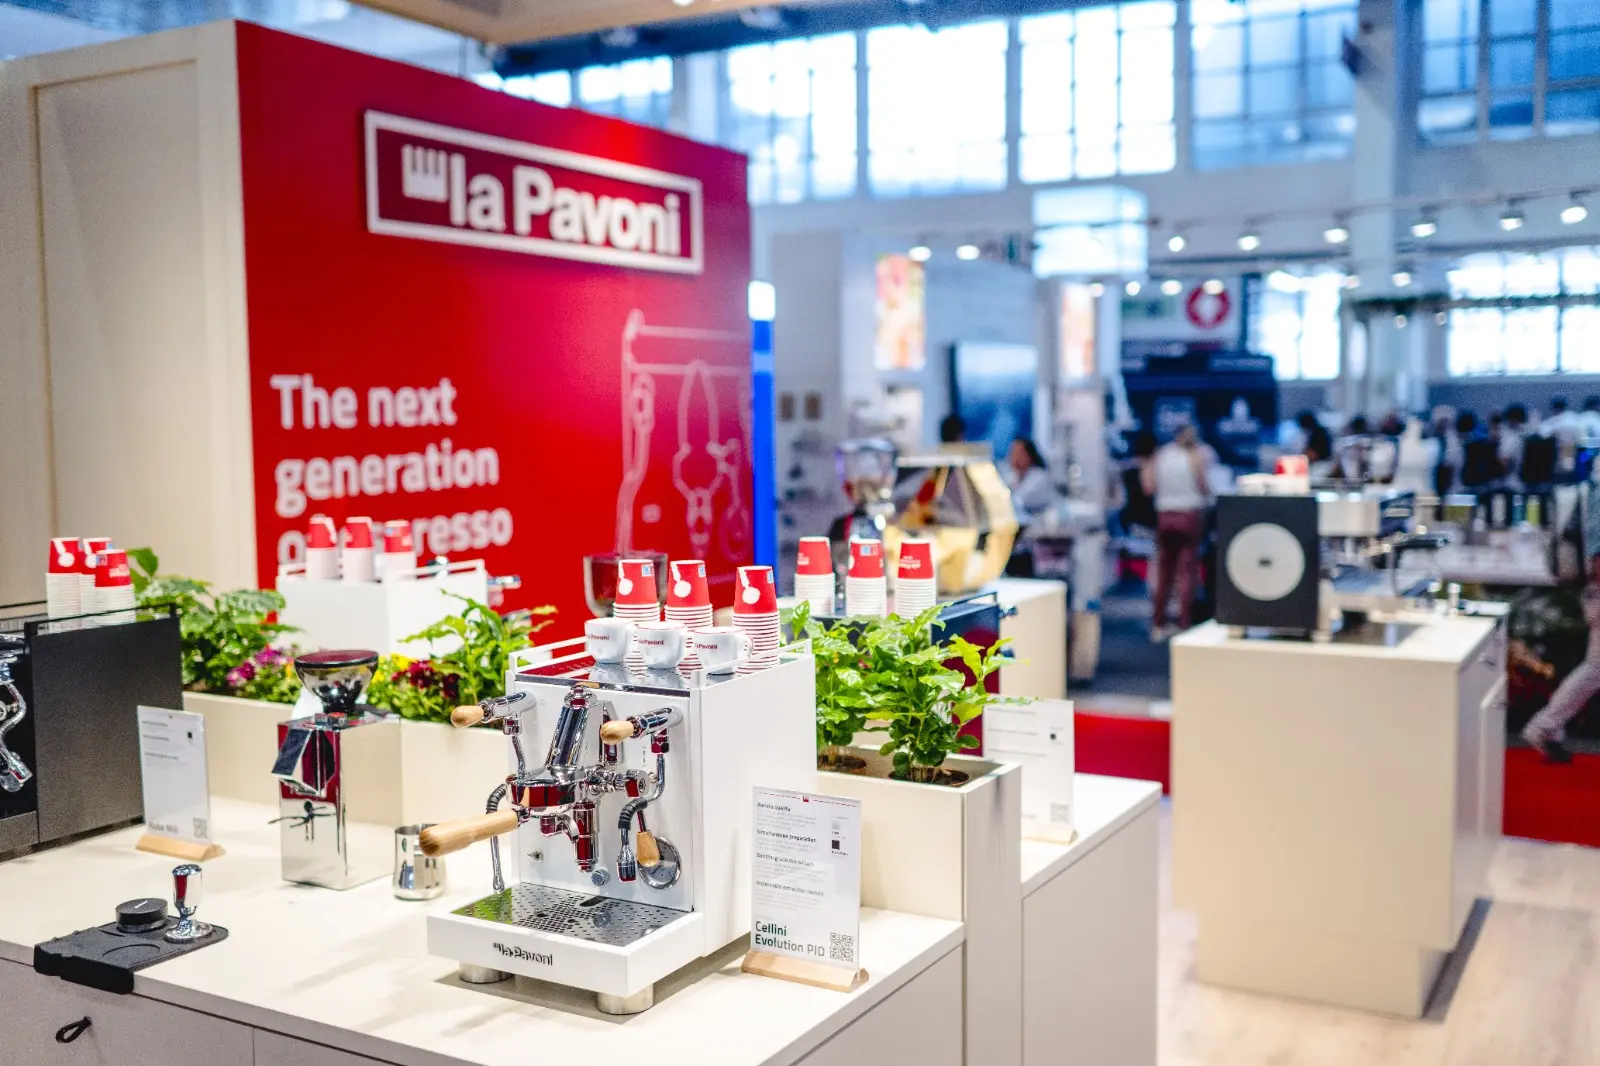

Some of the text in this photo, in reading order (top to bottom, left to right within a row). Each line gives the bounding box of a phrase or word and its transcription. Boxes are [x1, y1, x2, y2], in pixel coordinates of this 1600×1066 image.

[450, 153, 681, 256] la Pavoni
[269, 374, 458, 430] The next
[275, 438, 500, 518] generation
[277, 513, 327, 565] o
[755, 920, 787, 936] Cellini
[755, 933, 825, 957] Evolution PID
[501, 943, 553, 966] la Pavoni
